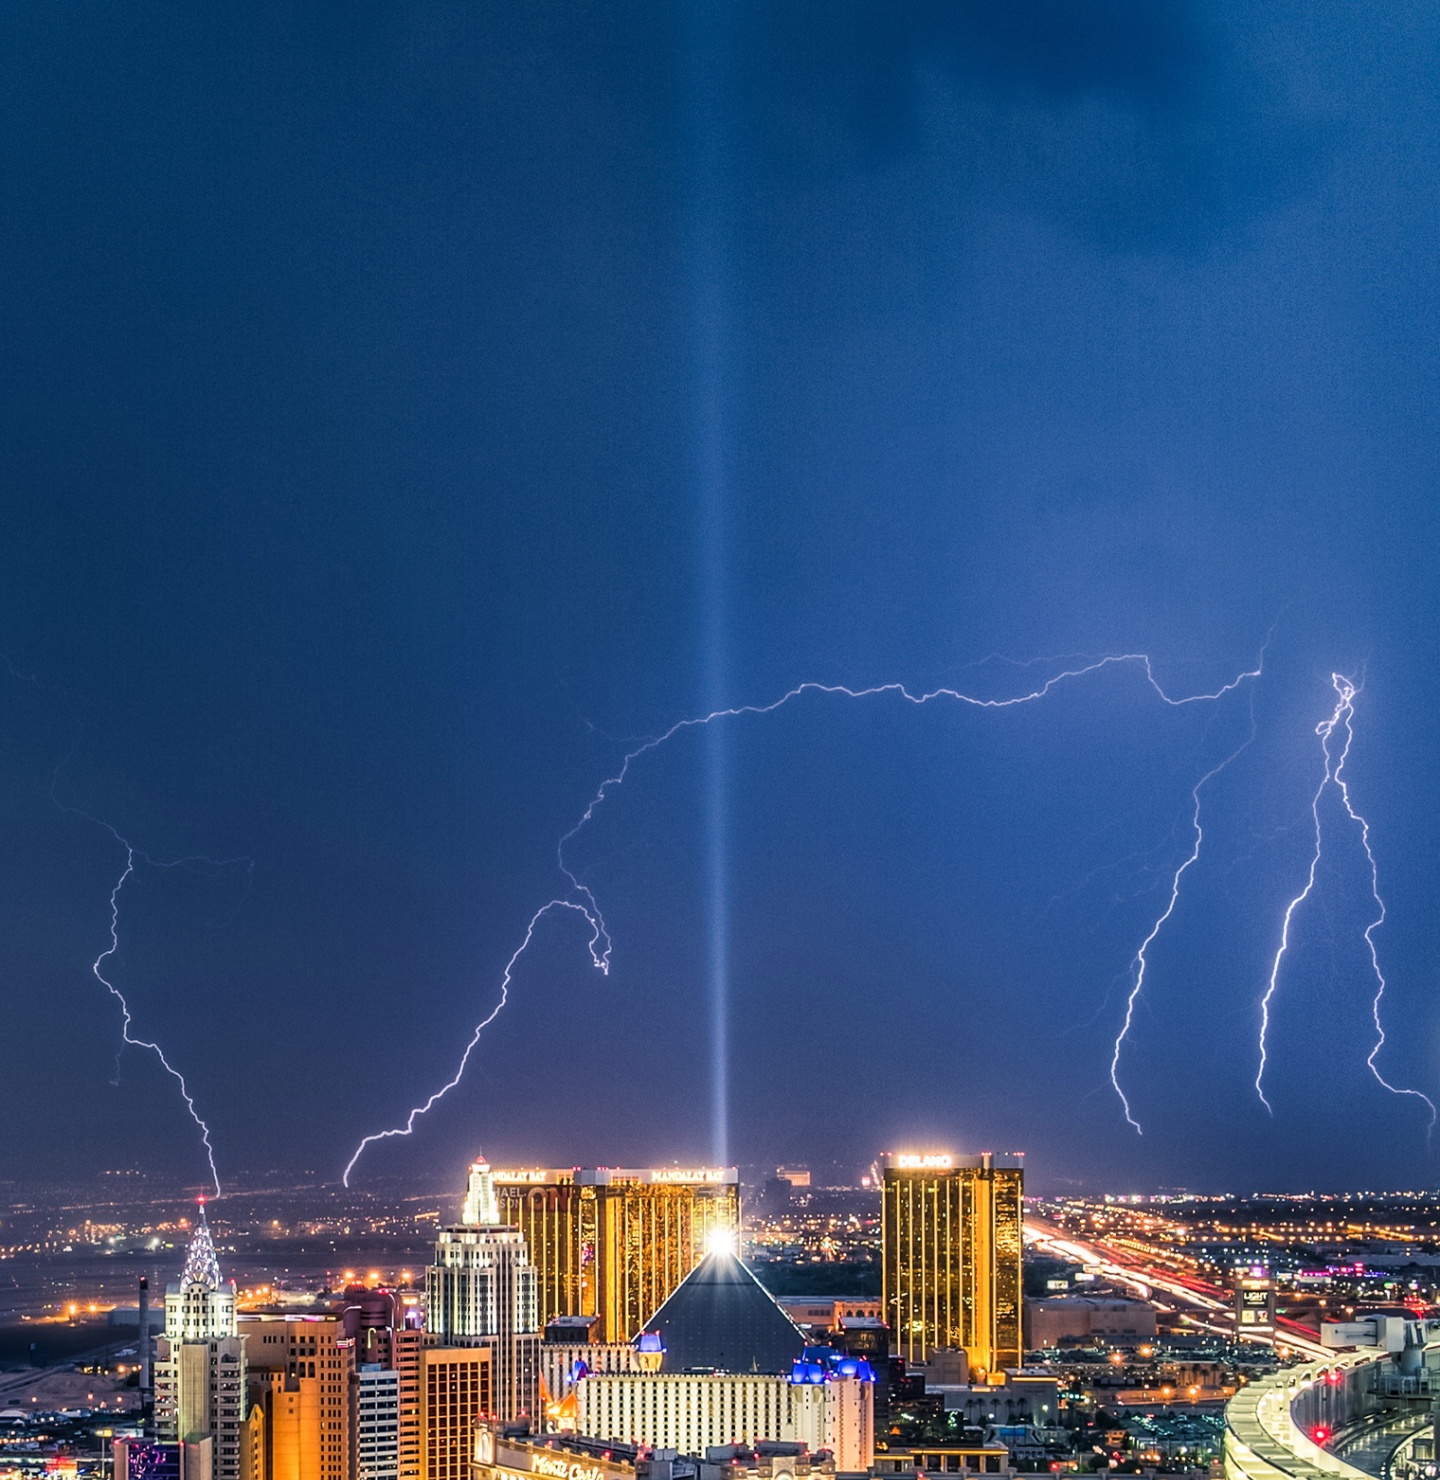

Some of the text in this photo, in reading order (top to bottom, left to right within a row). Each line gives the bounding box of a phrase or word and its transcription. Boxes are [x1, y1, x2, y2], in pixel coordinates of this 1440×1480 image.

[898, 1155, 952, 1168] DELANO
[529, 1171, 547, 1182] BAY
[651, 1171, 724, 1182] MANDALAY BAY
[494, 1187, 524, 1198] HAEL
[1243, 1292, 1269, 1300] LIGHT
[531, 1453, 568, 1479] Monte
